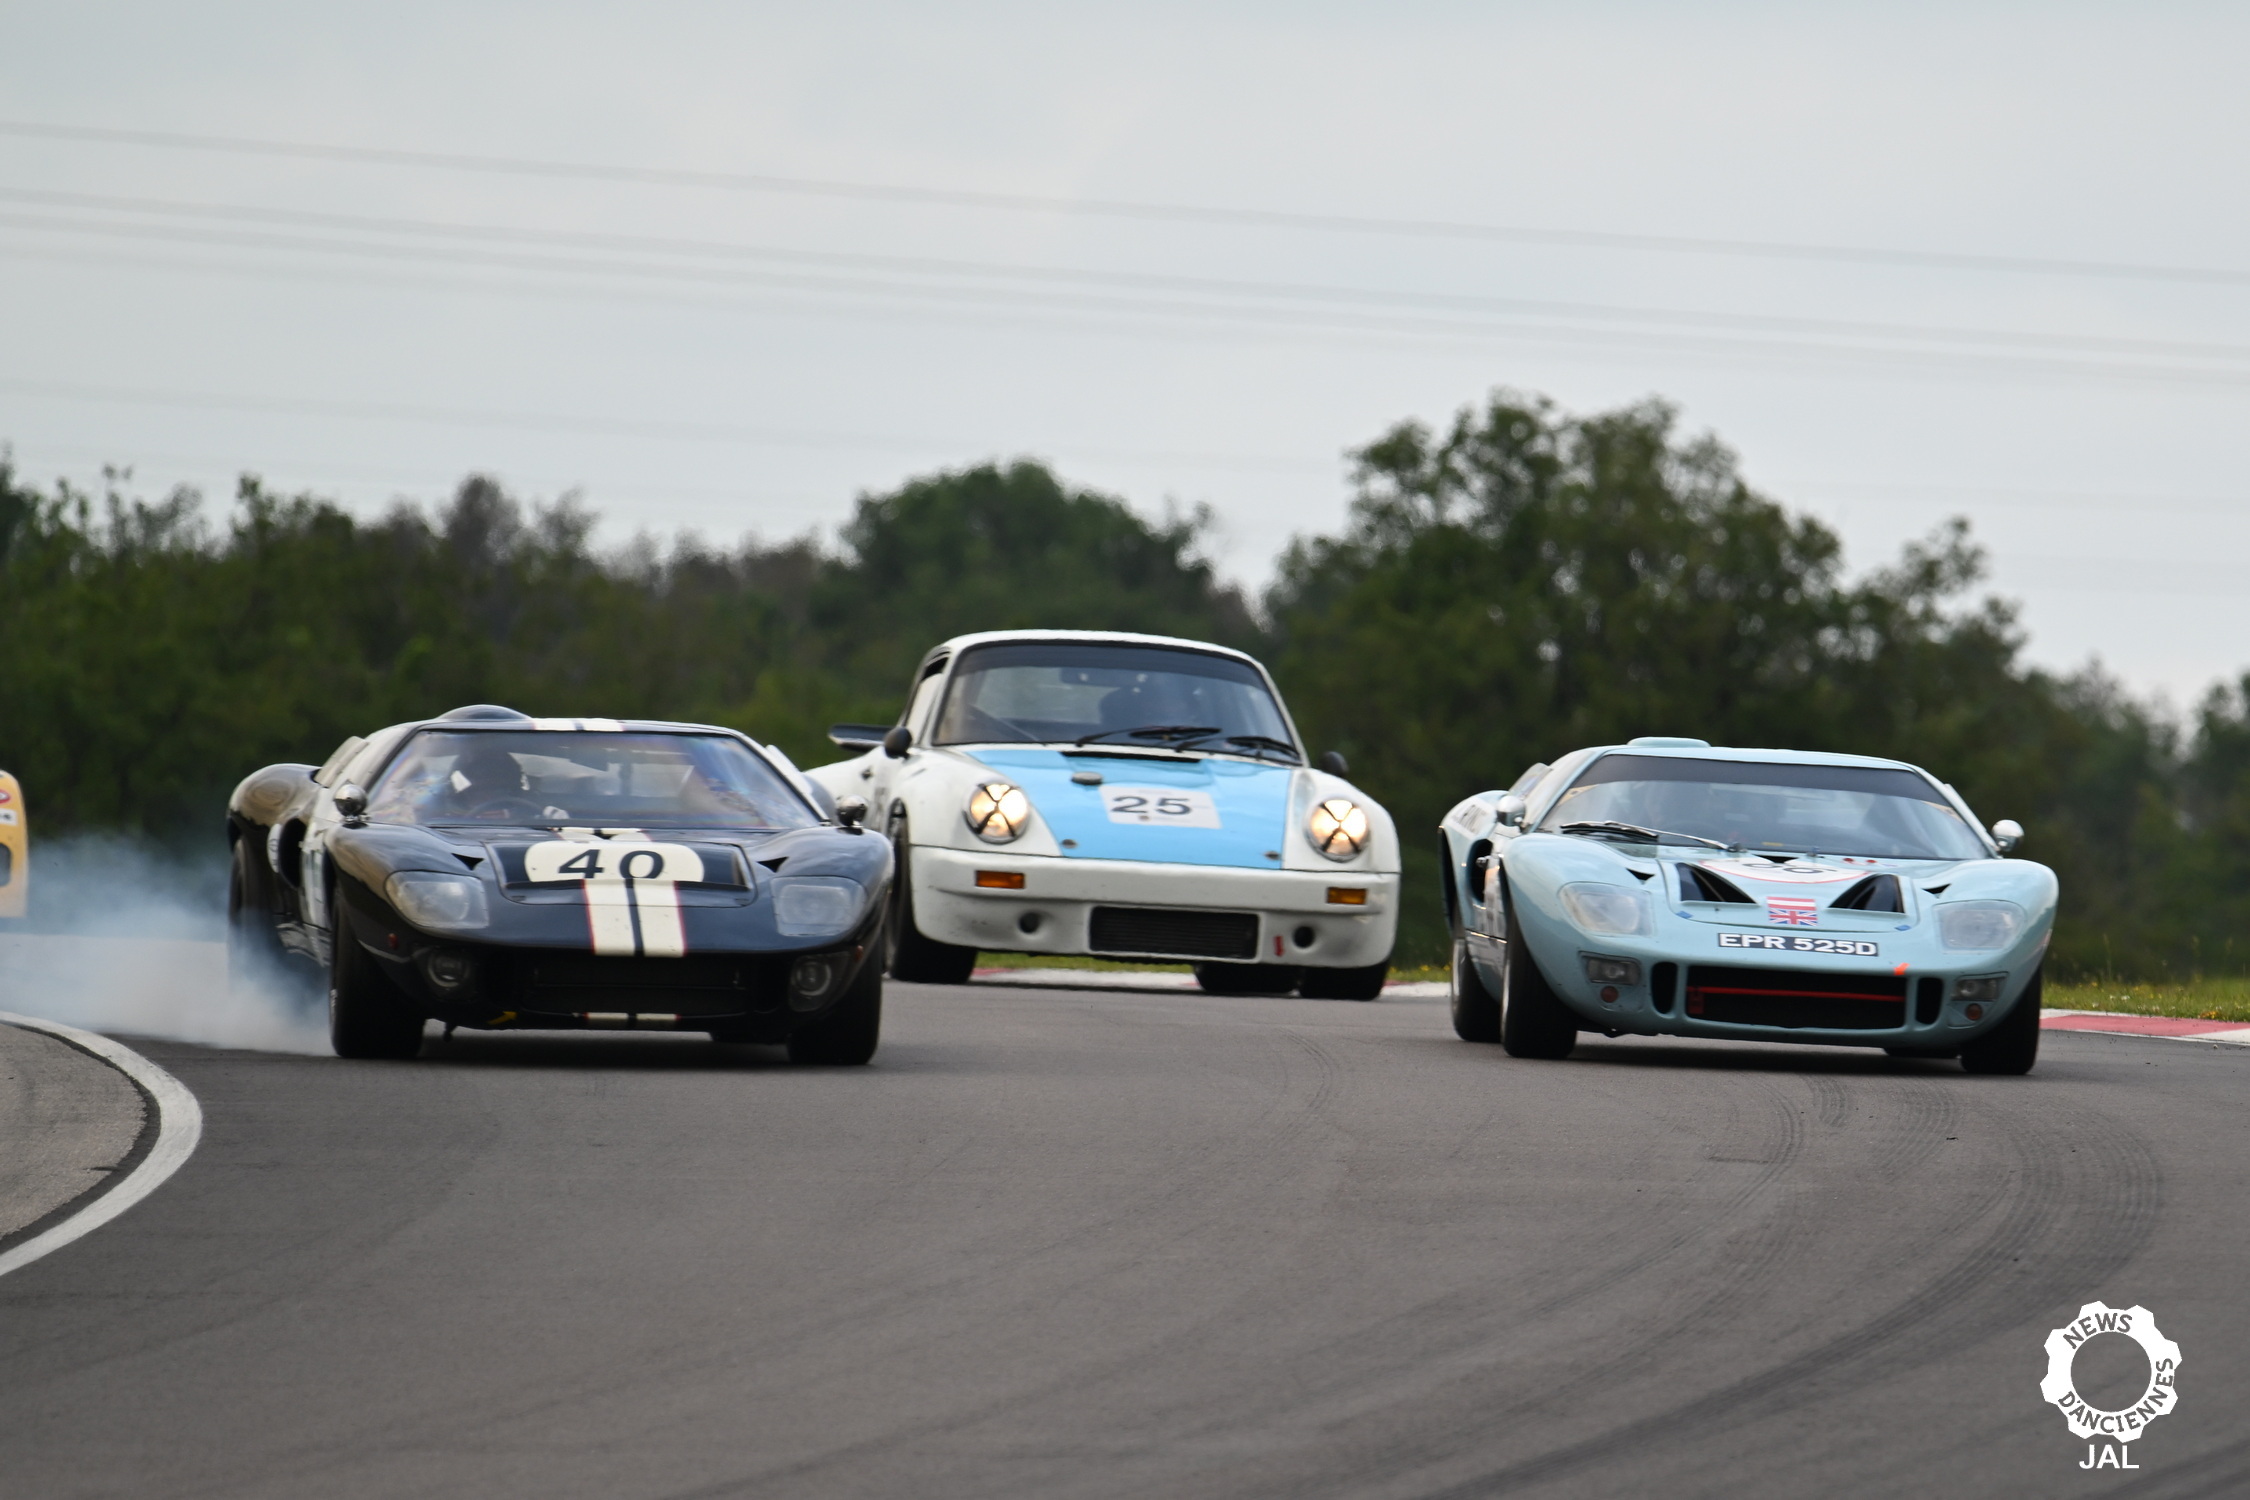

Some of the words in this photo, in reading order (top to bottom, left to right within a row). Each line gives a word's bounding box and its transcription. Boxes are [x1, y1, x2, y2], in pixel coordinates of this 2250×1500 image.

[1110, 796, 1192, 815] 25
[557, 848, 665, 879] 40
[1719, 933, 1786, 950] EPR
[1793, 937, 1878, 956] 525D
